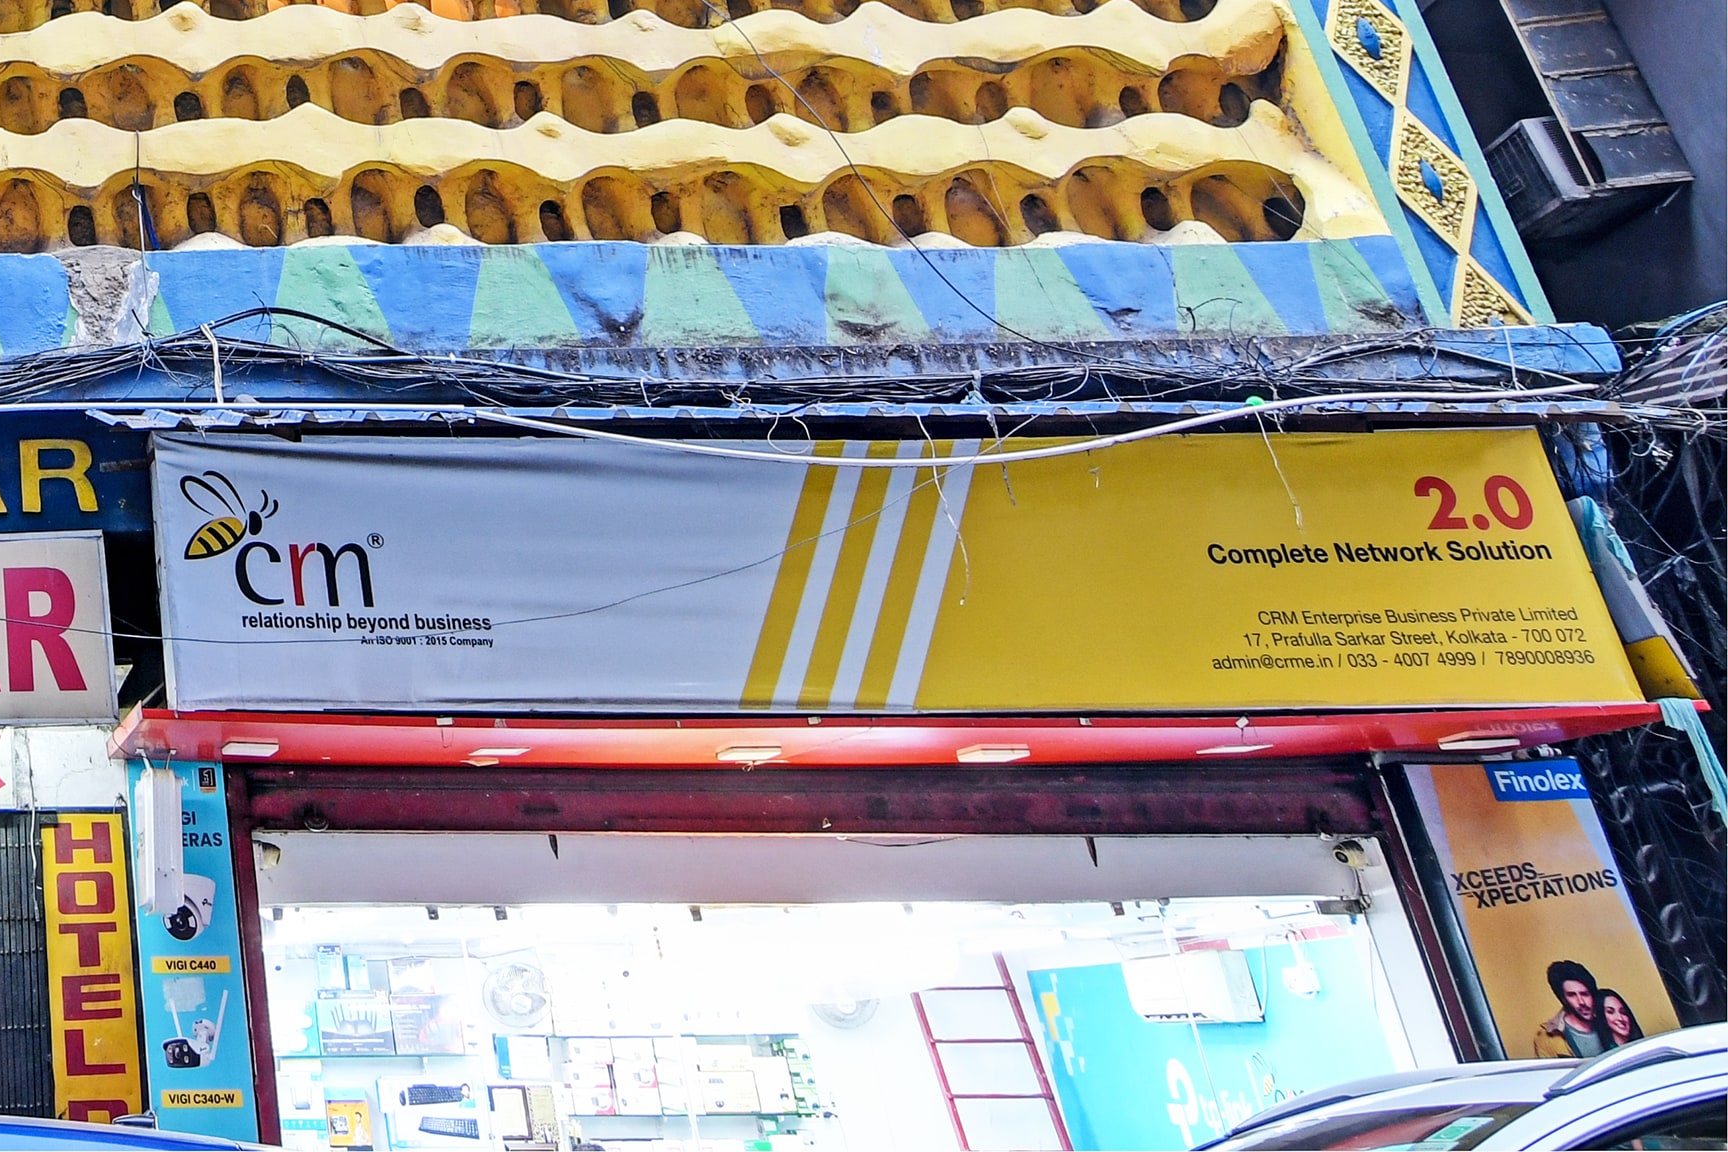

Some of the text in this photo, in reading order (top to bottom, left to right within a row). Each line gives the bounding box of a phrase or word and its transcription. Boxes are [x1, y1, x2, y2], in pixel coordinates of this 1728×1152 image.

[1414, 474, 1534, 531] 2.0
[1207, 539, 1554, 568] Complete Network Solution
[242, 612, 493, 634] relationship beyond business
[1257, 606, 1579, 629] CRM Enterprise Business Private Limited
[360, 636, 375, 646] An
[376, 636, 394, 646] ISO
[396, 636, 417, 646] 9001
[425, 636, 448, 647] 2015
[449, 636, 494, 649] Company
[1272, 630, 1333, 648] Prafulla
[1336, 630, 1386, 647] Sarkar
[1389, 629, 1443, 647] Street,
[1447, 628, 1508, 645] Kolkata
[1522, 628, 1554, 644] 700
[1556, 627, 1587, 643] 072
[1211, 653, 1334, 671] admin@crme.in
[1347, 652, 1378, 668] 033
[1393, 652, 1431, 667] 4007
[1437, 651, 1477, 667] 4999
[1494, 649, 1595, 666] 7890008936
[1493, 769, 1587, 792] Finolex
[1451, 862, 1539, 891] XCEEDS
[1474, 869, 1618, 909] XPECTATIONS
[54, 821, 127, 1077] HOTEL
[165, 960, 216, 970] VIGI C440
[168, 1093, 236, 1104] VIGI C340-W
